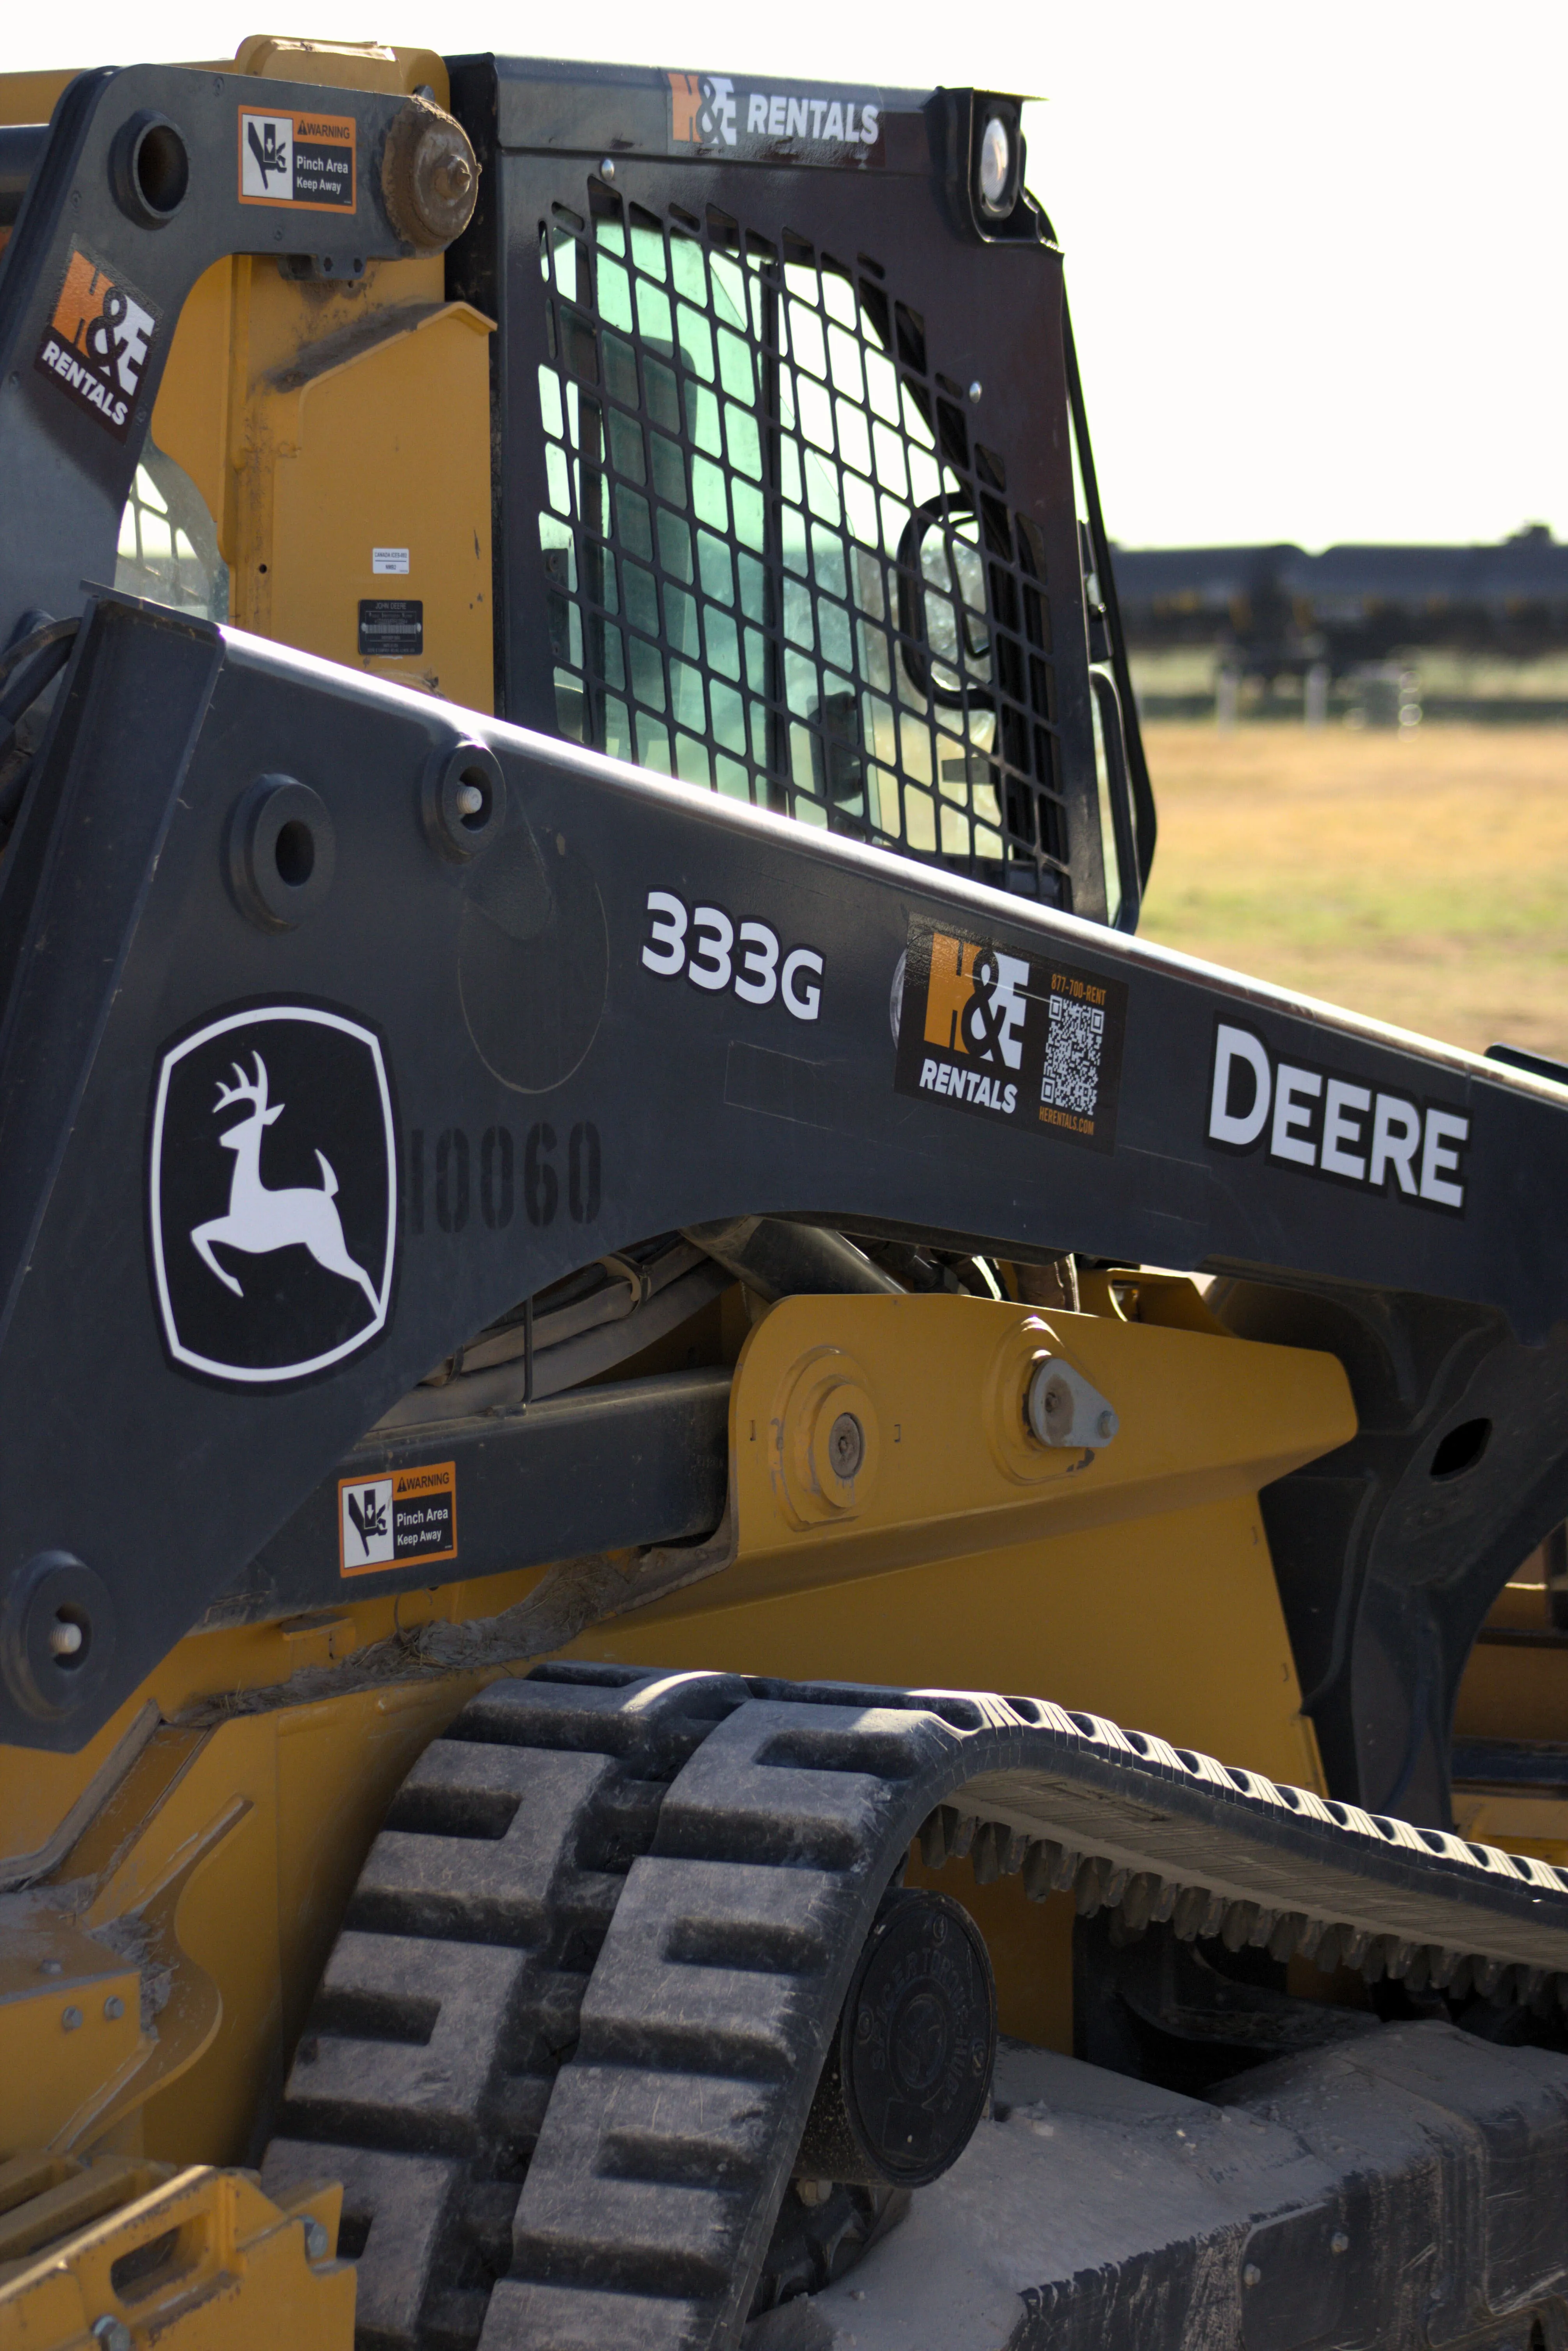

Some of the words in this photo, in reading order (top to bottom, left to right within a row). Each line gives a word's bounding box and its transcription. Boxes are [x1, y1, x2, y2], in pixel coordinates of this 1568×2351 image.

[307, 123, 350, 139] WARNING
[667, 73, 737, 146] H&E
[747, 94, 879, 145] RENTALS
[297, 155, 324, 172] Pinch
[326, 159, 348, 174] Area
[297, 175, 317, 192] Keep
[319, 179, 342, 194] Away
[52, 250, 155, 396] H&E
[41, 340, 128, 425] RENTALS
[642, 892, 823, 1020] 333G
[924, 932, 1030, 1070] H&E
[1051, 973, 1106, 1006] 877-700-RENT
[919, 1058, 1018, 1114] RENTALS
[1039, 1106, 1095, 1136] HERENTALS.COM
[1209, 1023, 1470, 1208] DEERE
[411, 1121, 601, 1234] 10060
[407, 1472, 449, 1490] WARNING
[397, 1510, 424, 1527] Pinch
[426, 1509, 448, 1522] Area
[397, 1534, 418, 1546] Keep
[420, 1530, 441, 1542] Away
